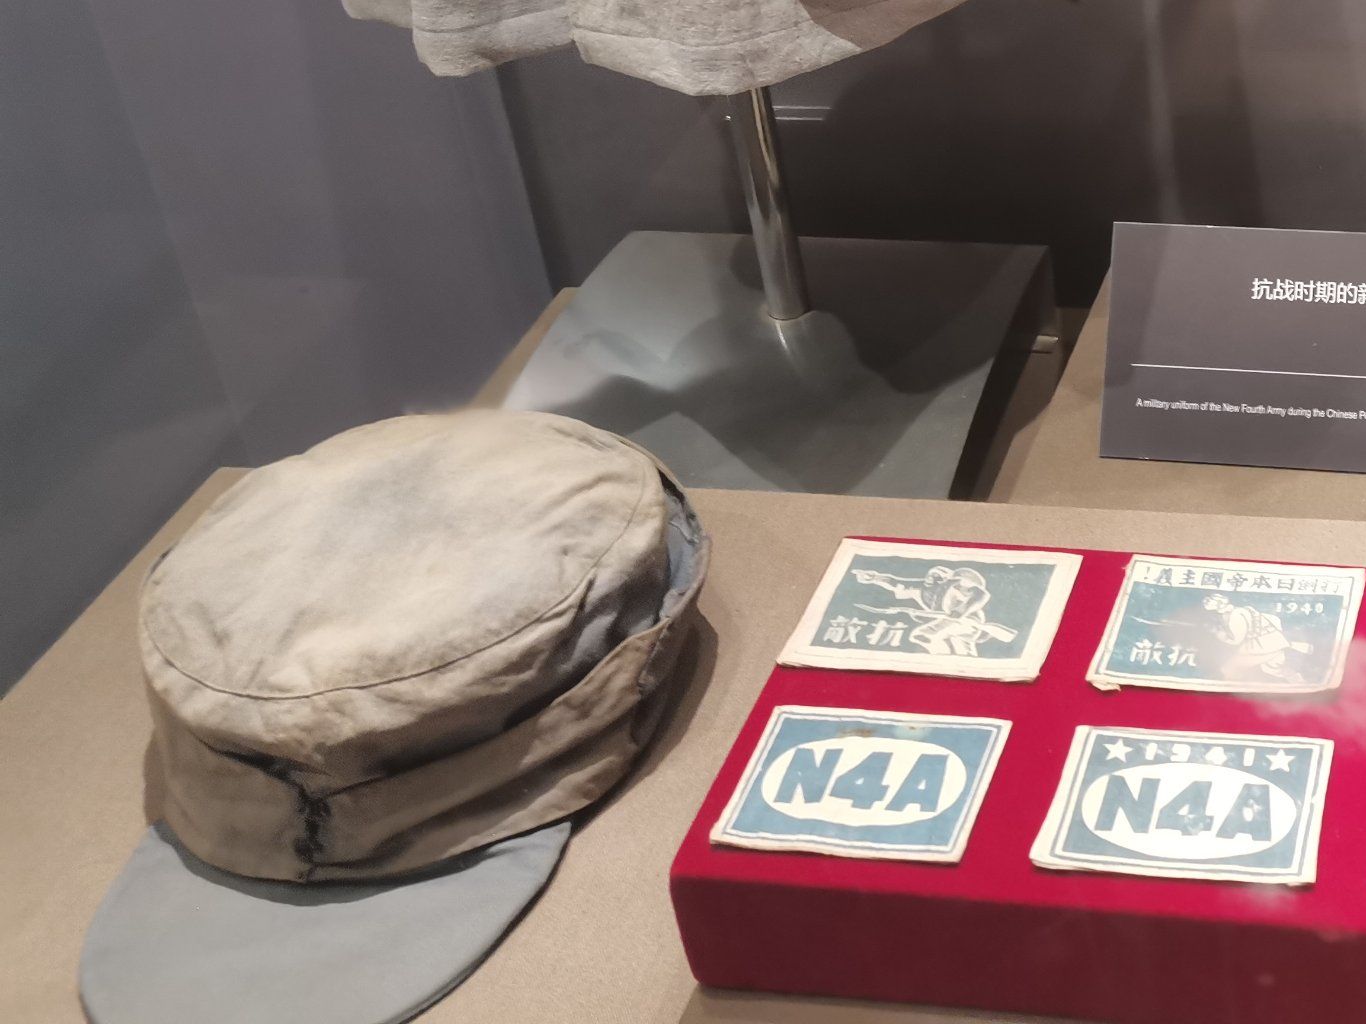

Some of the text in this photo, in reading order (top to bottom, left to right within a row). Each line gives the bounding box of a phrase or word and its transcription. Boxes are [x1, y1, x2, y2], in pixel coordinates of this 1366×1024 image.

[1136, 397, 1142, 407] A
[1143, 398, 1170, 410] military
[1171, 400, 1199, 410] uniform
[1200, 402, 1208, 411] of
[1209, 402, 1221, 411] the
[1222, 403, 1239, 412] New
[1241, 403, 1265, 413] Fourth
[1267, 405, 1286, 417] Army
[1287, 407, 1311, 418] during
[1313, 408, 1325, 417] the
[1326, 409, 1357, 419] Chinese
[1145, 742, 1255, 767] 1941
[772, 748, 950, 812] N4A
[1094, 775, 1274, 842] N4A
